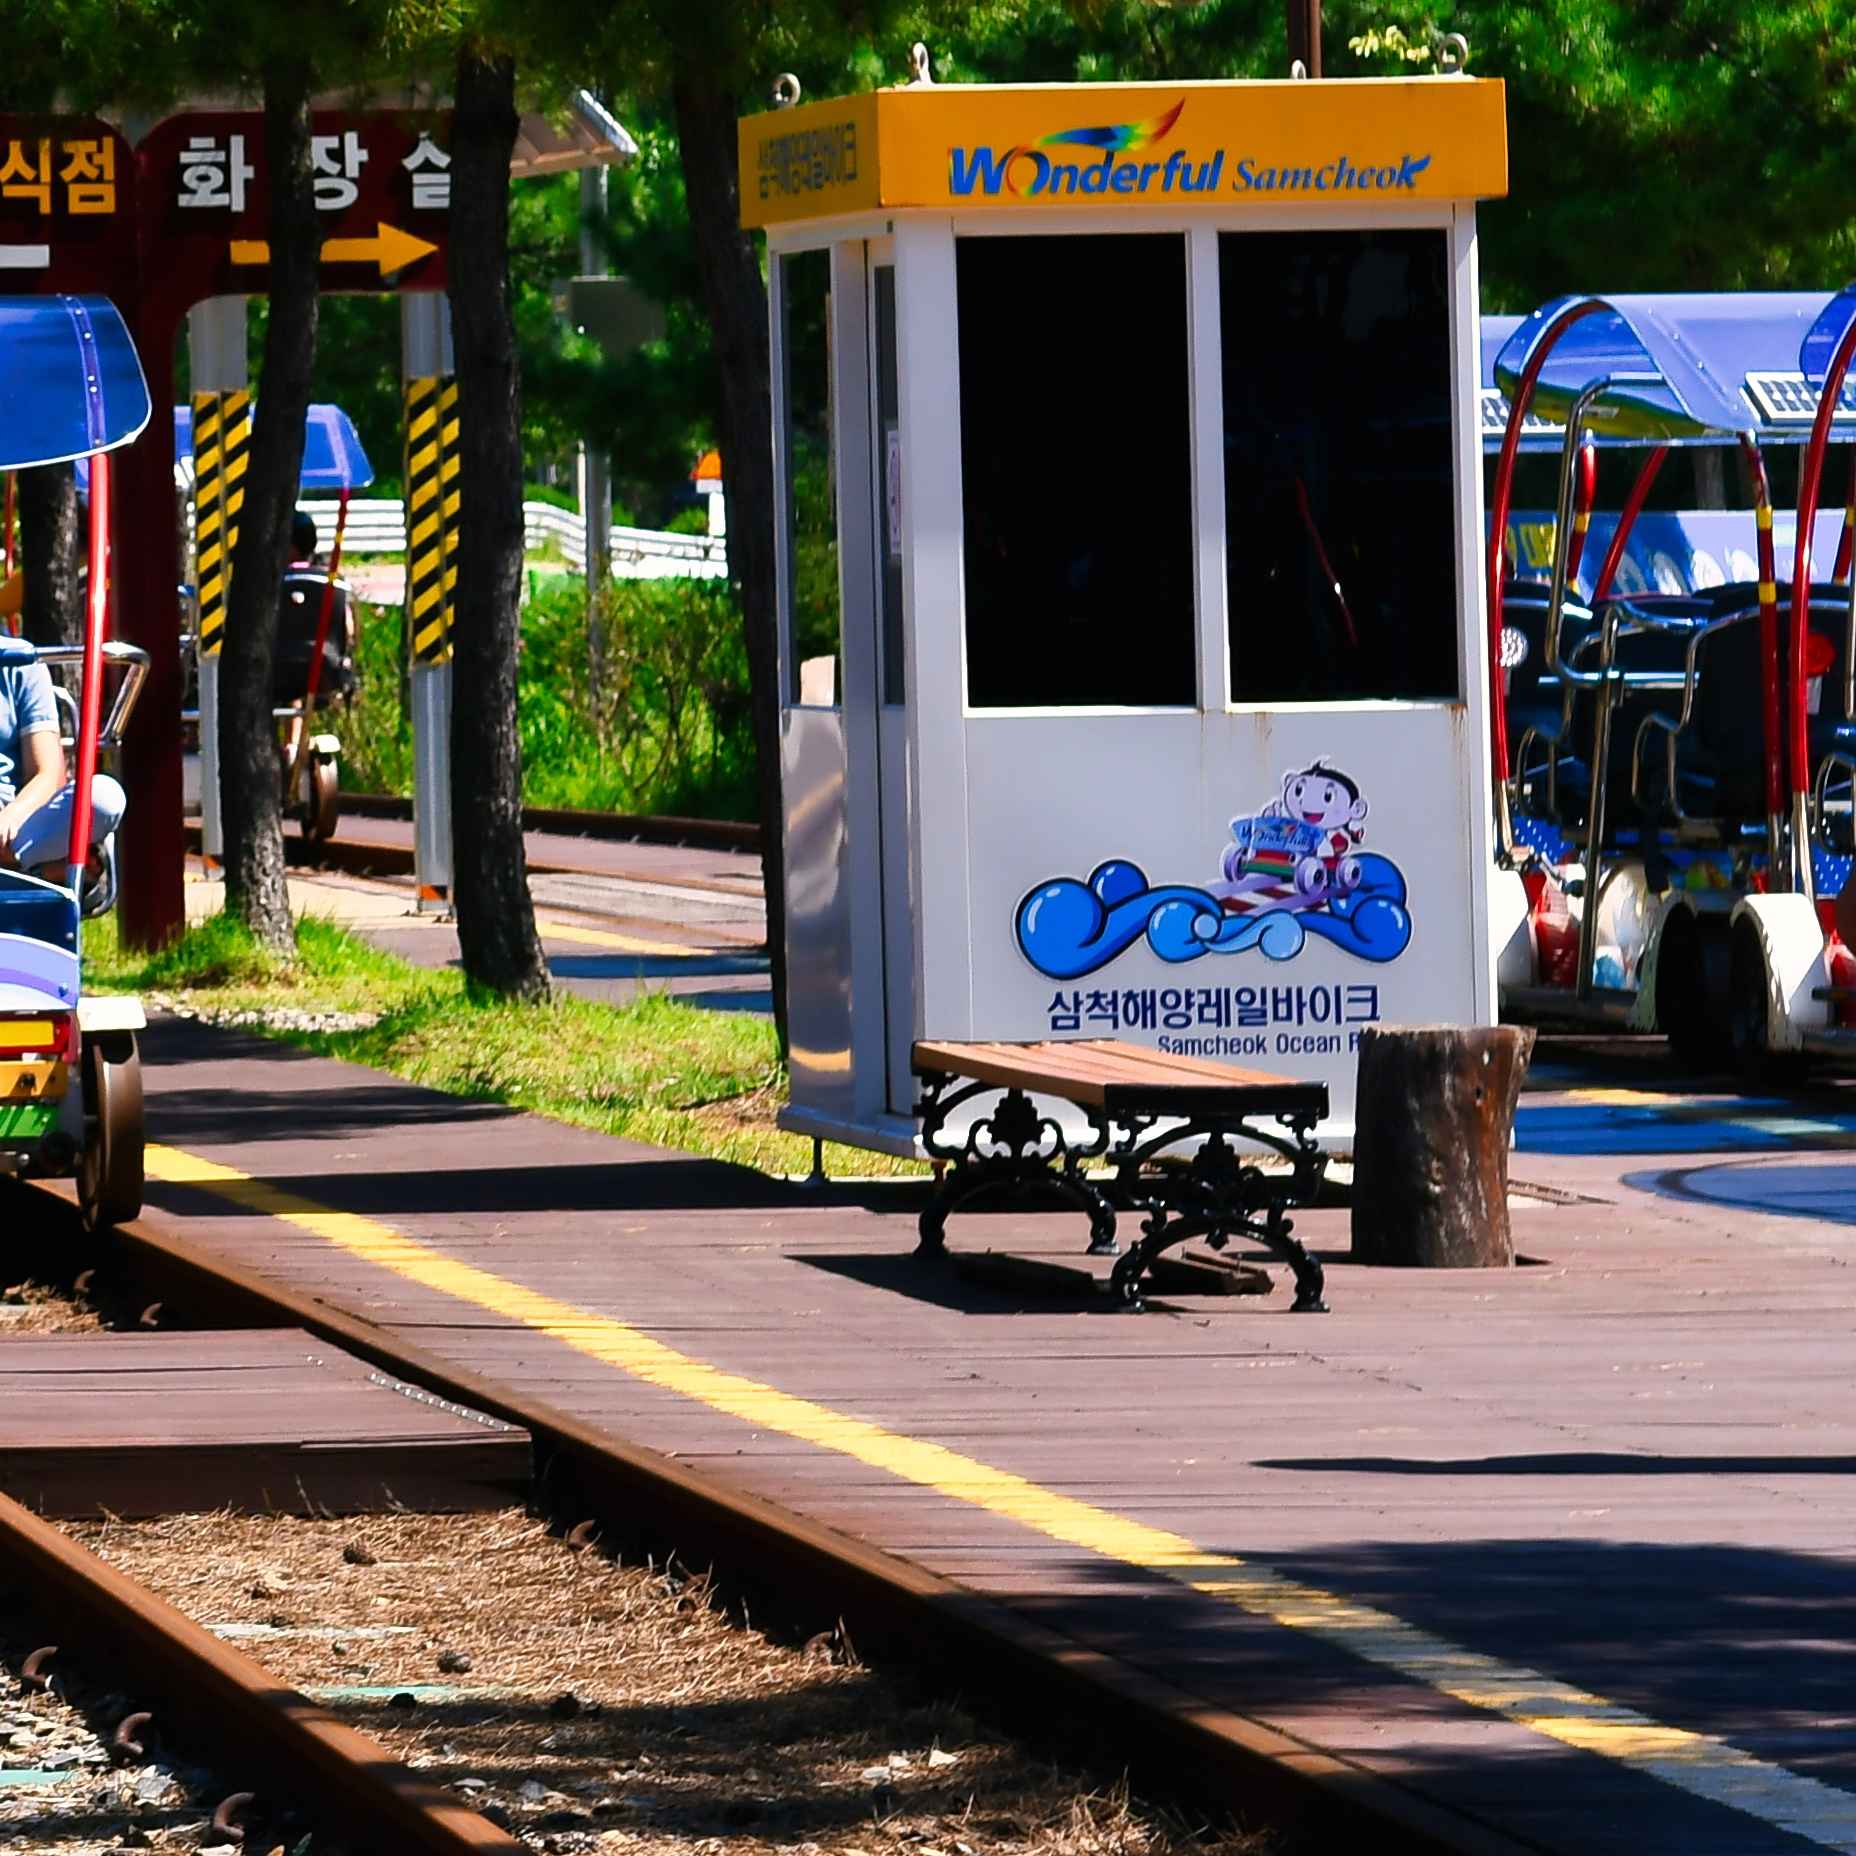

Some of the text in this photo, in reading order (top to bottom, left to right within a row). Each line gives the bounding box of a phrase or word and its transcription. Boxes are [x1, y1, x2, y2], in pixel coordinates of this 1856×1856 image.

[1232, 153, 1433, 192] Samcheok
[1047, 984, 1381, 1031] 삼척해양레일바이크
[1157, 1032, 1268, 1057] Samcheok
[1276, 1032, 1342, 1056] Ocean
